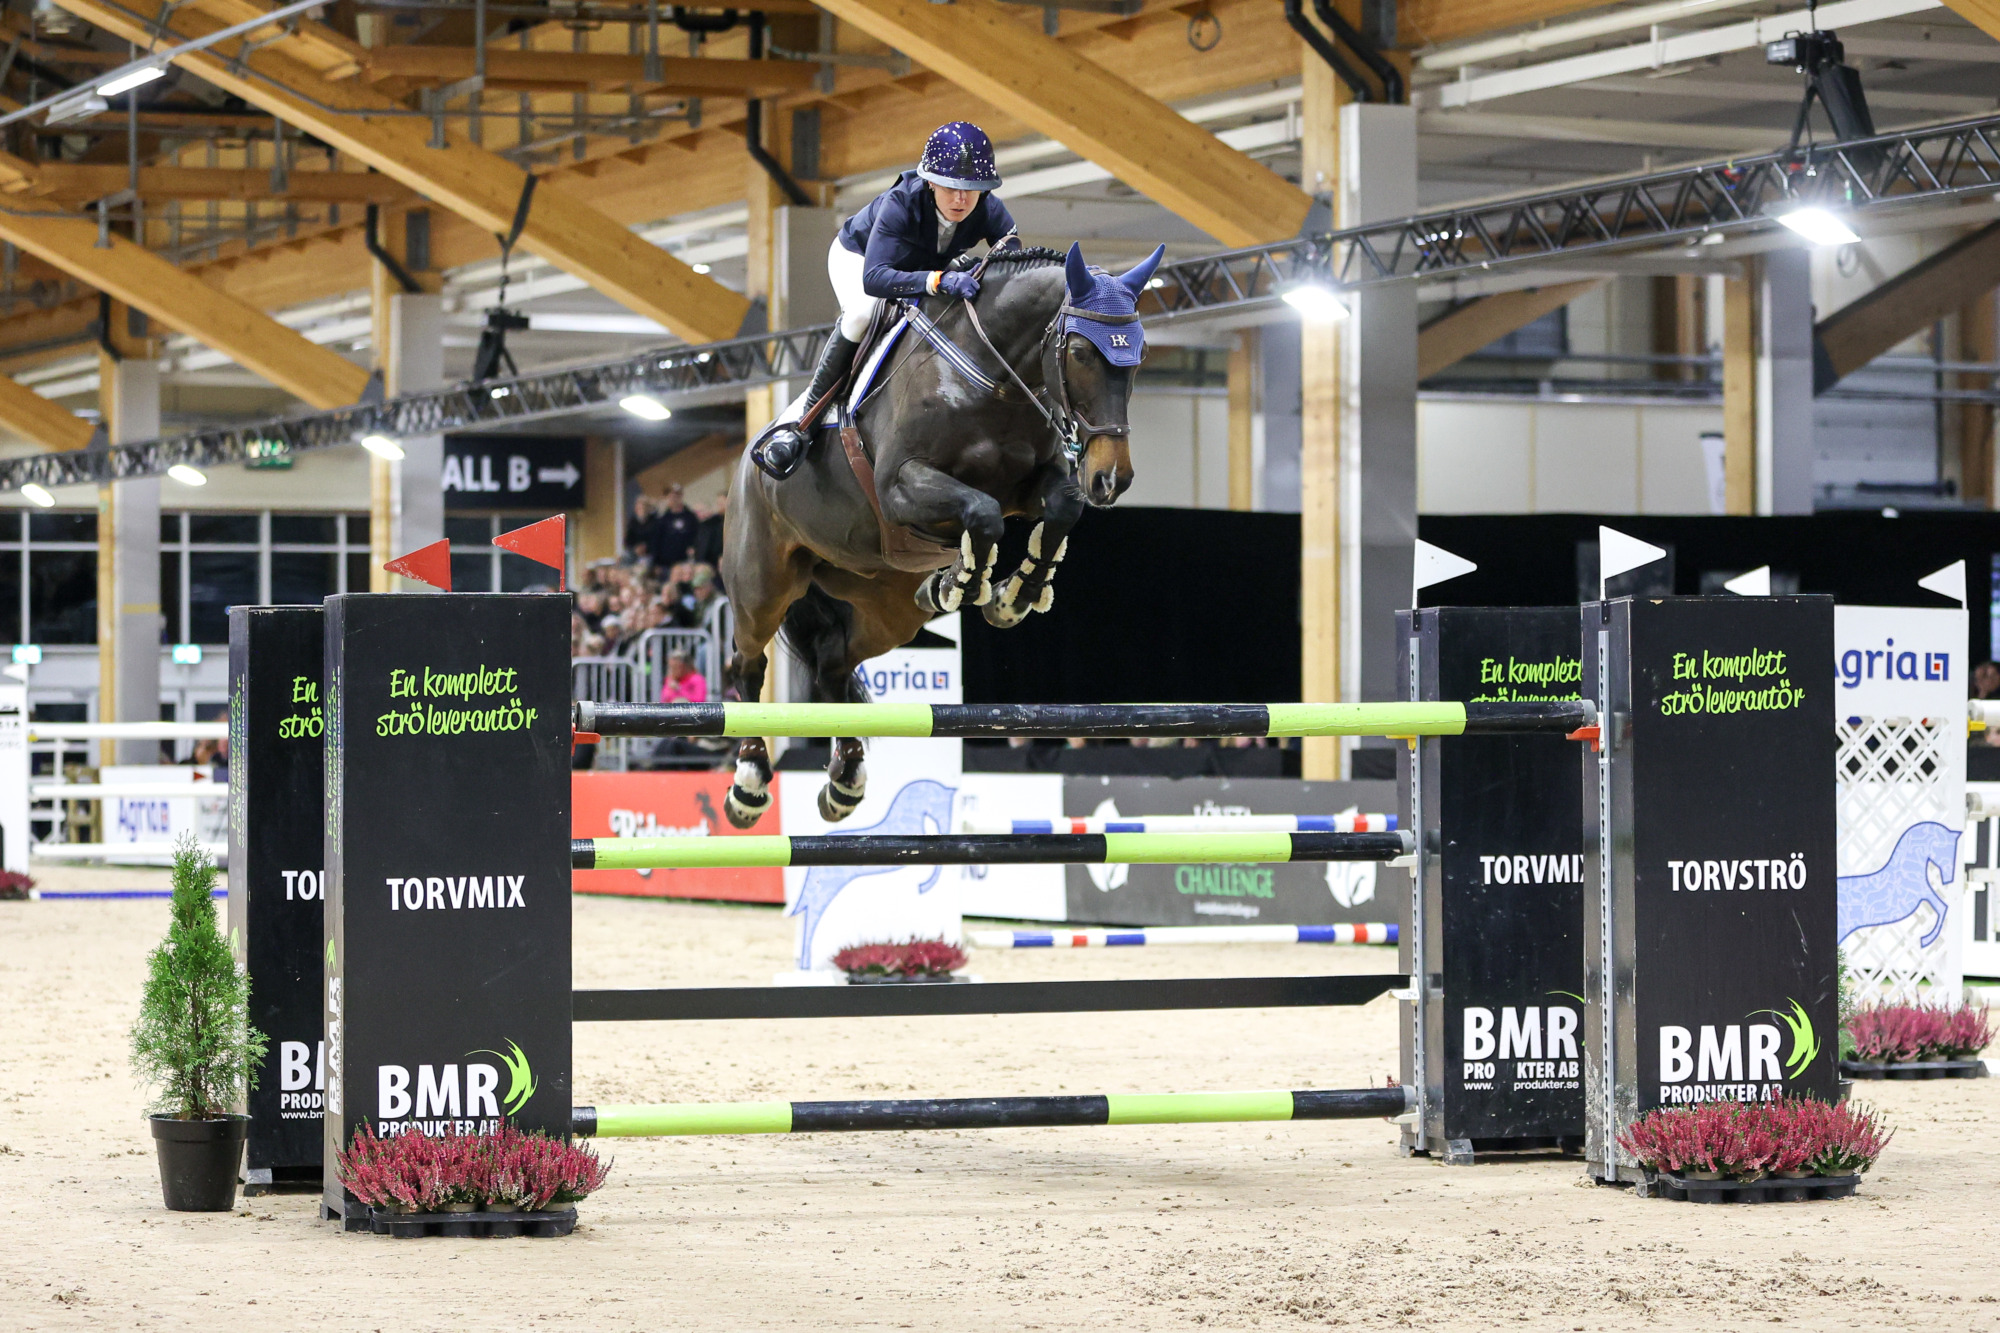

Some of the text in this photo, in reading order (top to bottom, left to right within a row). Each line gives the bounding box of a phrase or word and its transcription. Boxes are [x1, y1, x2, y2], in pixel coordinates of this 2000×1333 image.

[441, 455, 532, 492] ALL B
[857, 662, 926, 696] Agria
[1480, 657, 1505, 684] En
[1673, 647, 1787, 683] En komplett
[1834, 638, 1918, 689] gria
[292, 675, 319, 703] En
[390, 663, 518, 702] En komplett
[1660, 679, 1806, 716] ströleverantör
[278, 706, 325, 739] strö
[376, 698, 539, 737] ströleverantör
[281, 870, 325, 901] TO
[1175, 864, 1275, 898] CHALLENGE
[1479, 854, 1584, 885] TORVMI
[1667, 852, 1807, 892] TORVSTRÖ
[386, 875, 526, 911] TORVMIX
[1463, 1006, 1579, 1060] BMR
[1558, 1061, 1579, 1078] AB
[1659, 1024, 1783, 1083] BMR
[281, 1092, 325, 1110] PROD
[378, 1063, 500, 1118] BMR
[1660, 1084, 1758, 1104] PRODUKTER
[281, 1110, 325, 1119] www.bm
